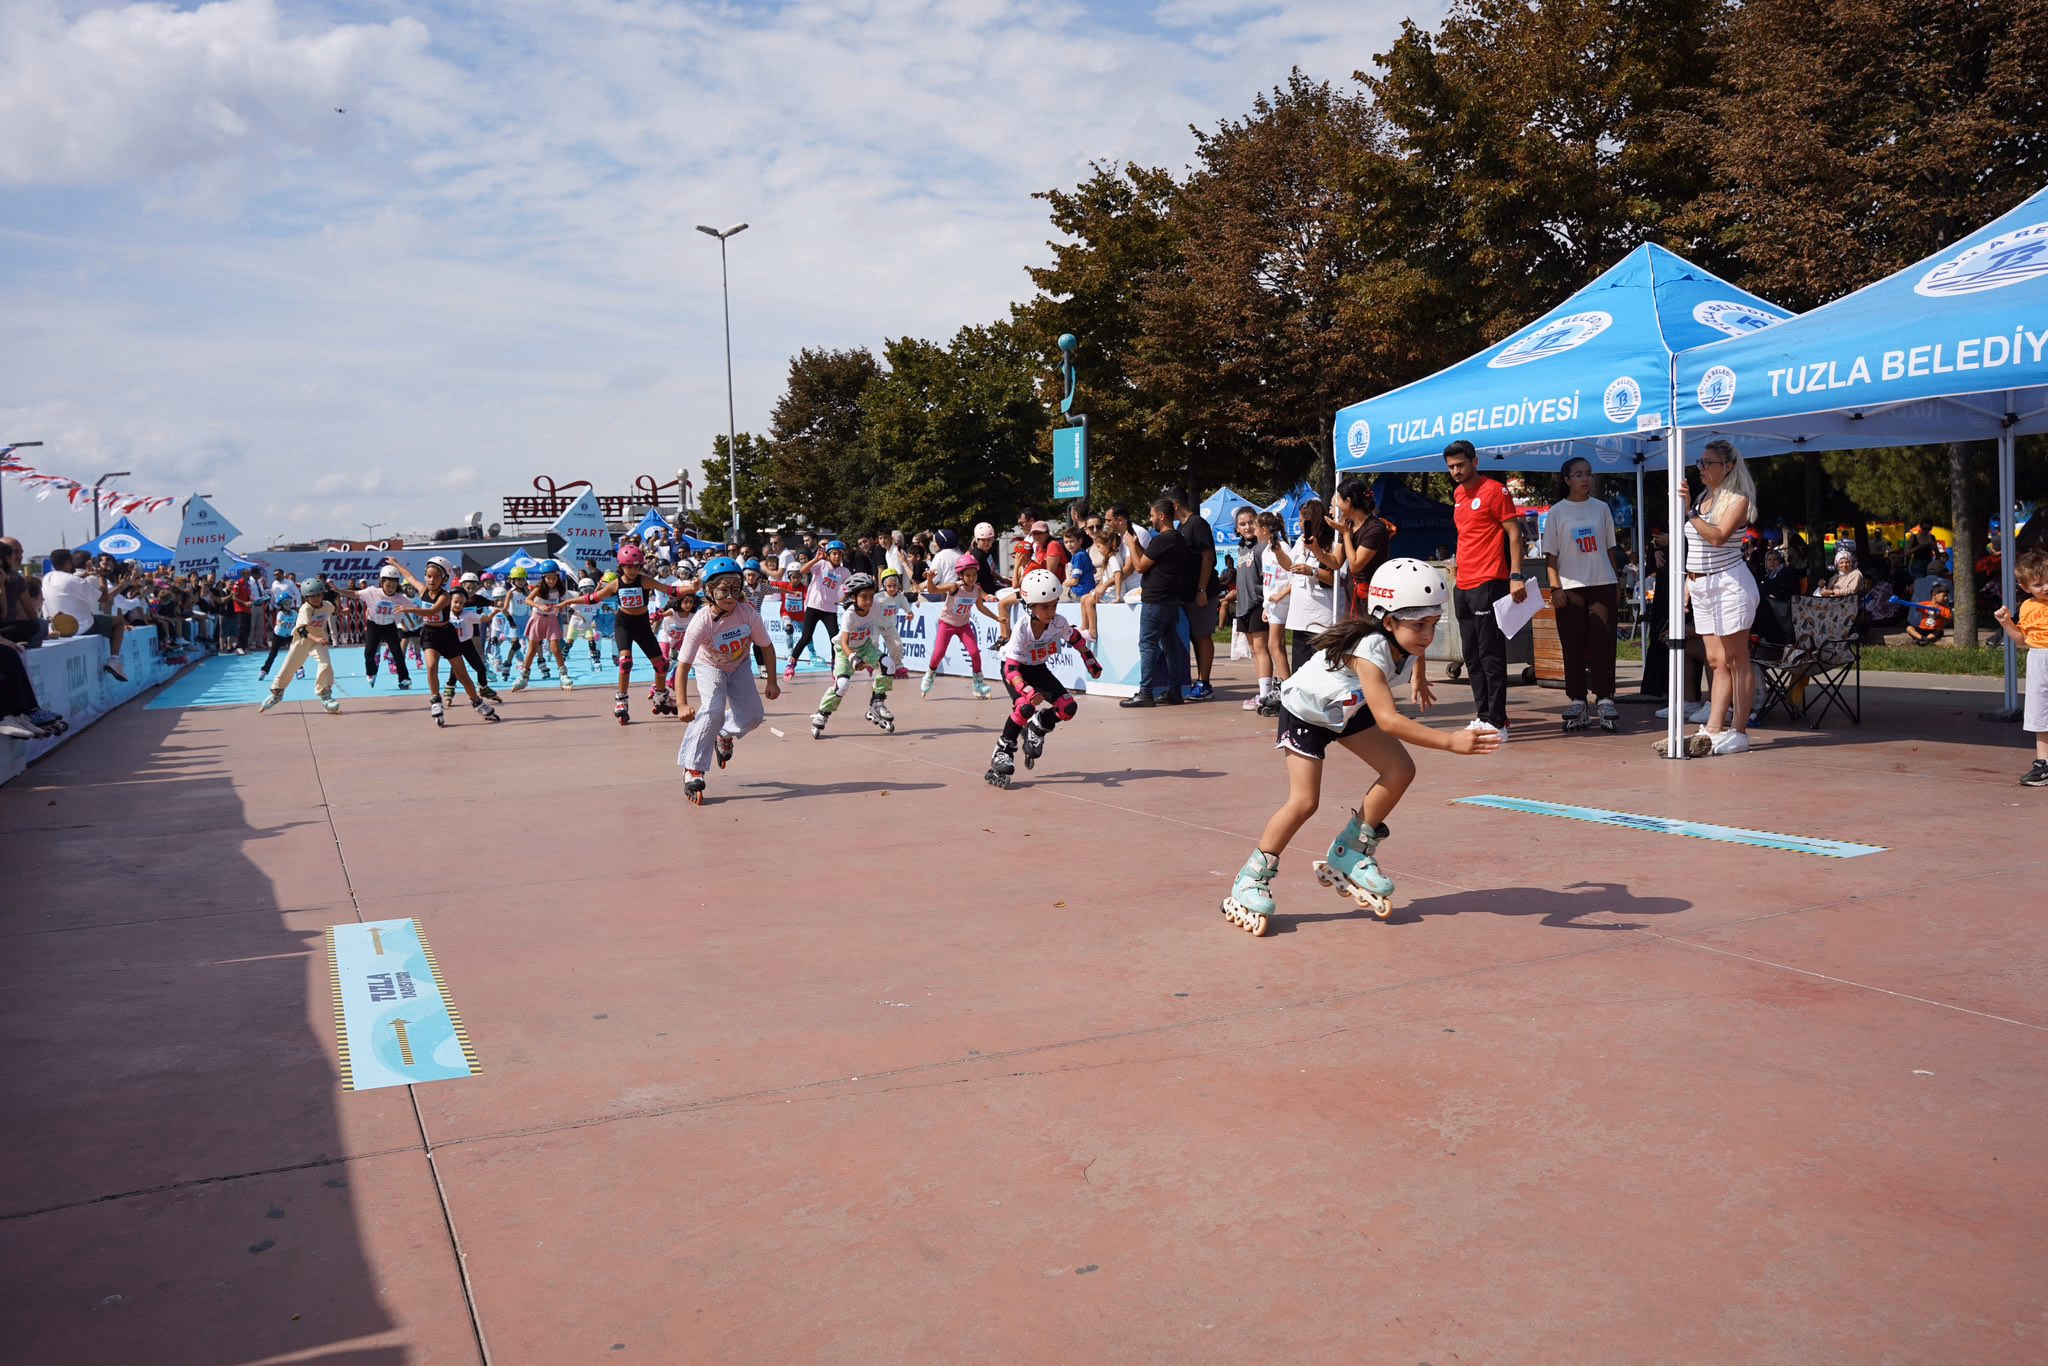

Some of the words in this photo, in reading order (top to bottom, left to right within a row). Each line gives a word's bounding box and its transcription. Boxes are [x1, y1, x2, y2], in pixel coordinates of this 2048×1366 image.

[1768, 356, 1871, 397] TUZLA
[1388, 415, 1445, 445] TUZLA
[1450, 390, 1580, 434] BELEDİYESİ
[566, 527, 605, 538] START
[184, 533, 226, 546] FINISH
[575, 548, 612, 557] TUZLA
[178, 556, 220, 569] TUZLA
[321, 557, 389, 572] TUZLA
[1369, 585, 1395, 599] ROCES
[621, 595, 644, 608] 223
[787, 603, 801, 612] 241
[895, 614, 926, 639] UZLA
[721, 628, 742, 639] TUZLA
[1047, 653, 1074, 669] AŞKANI
[366, 972, 398, 1002] TUZLA
